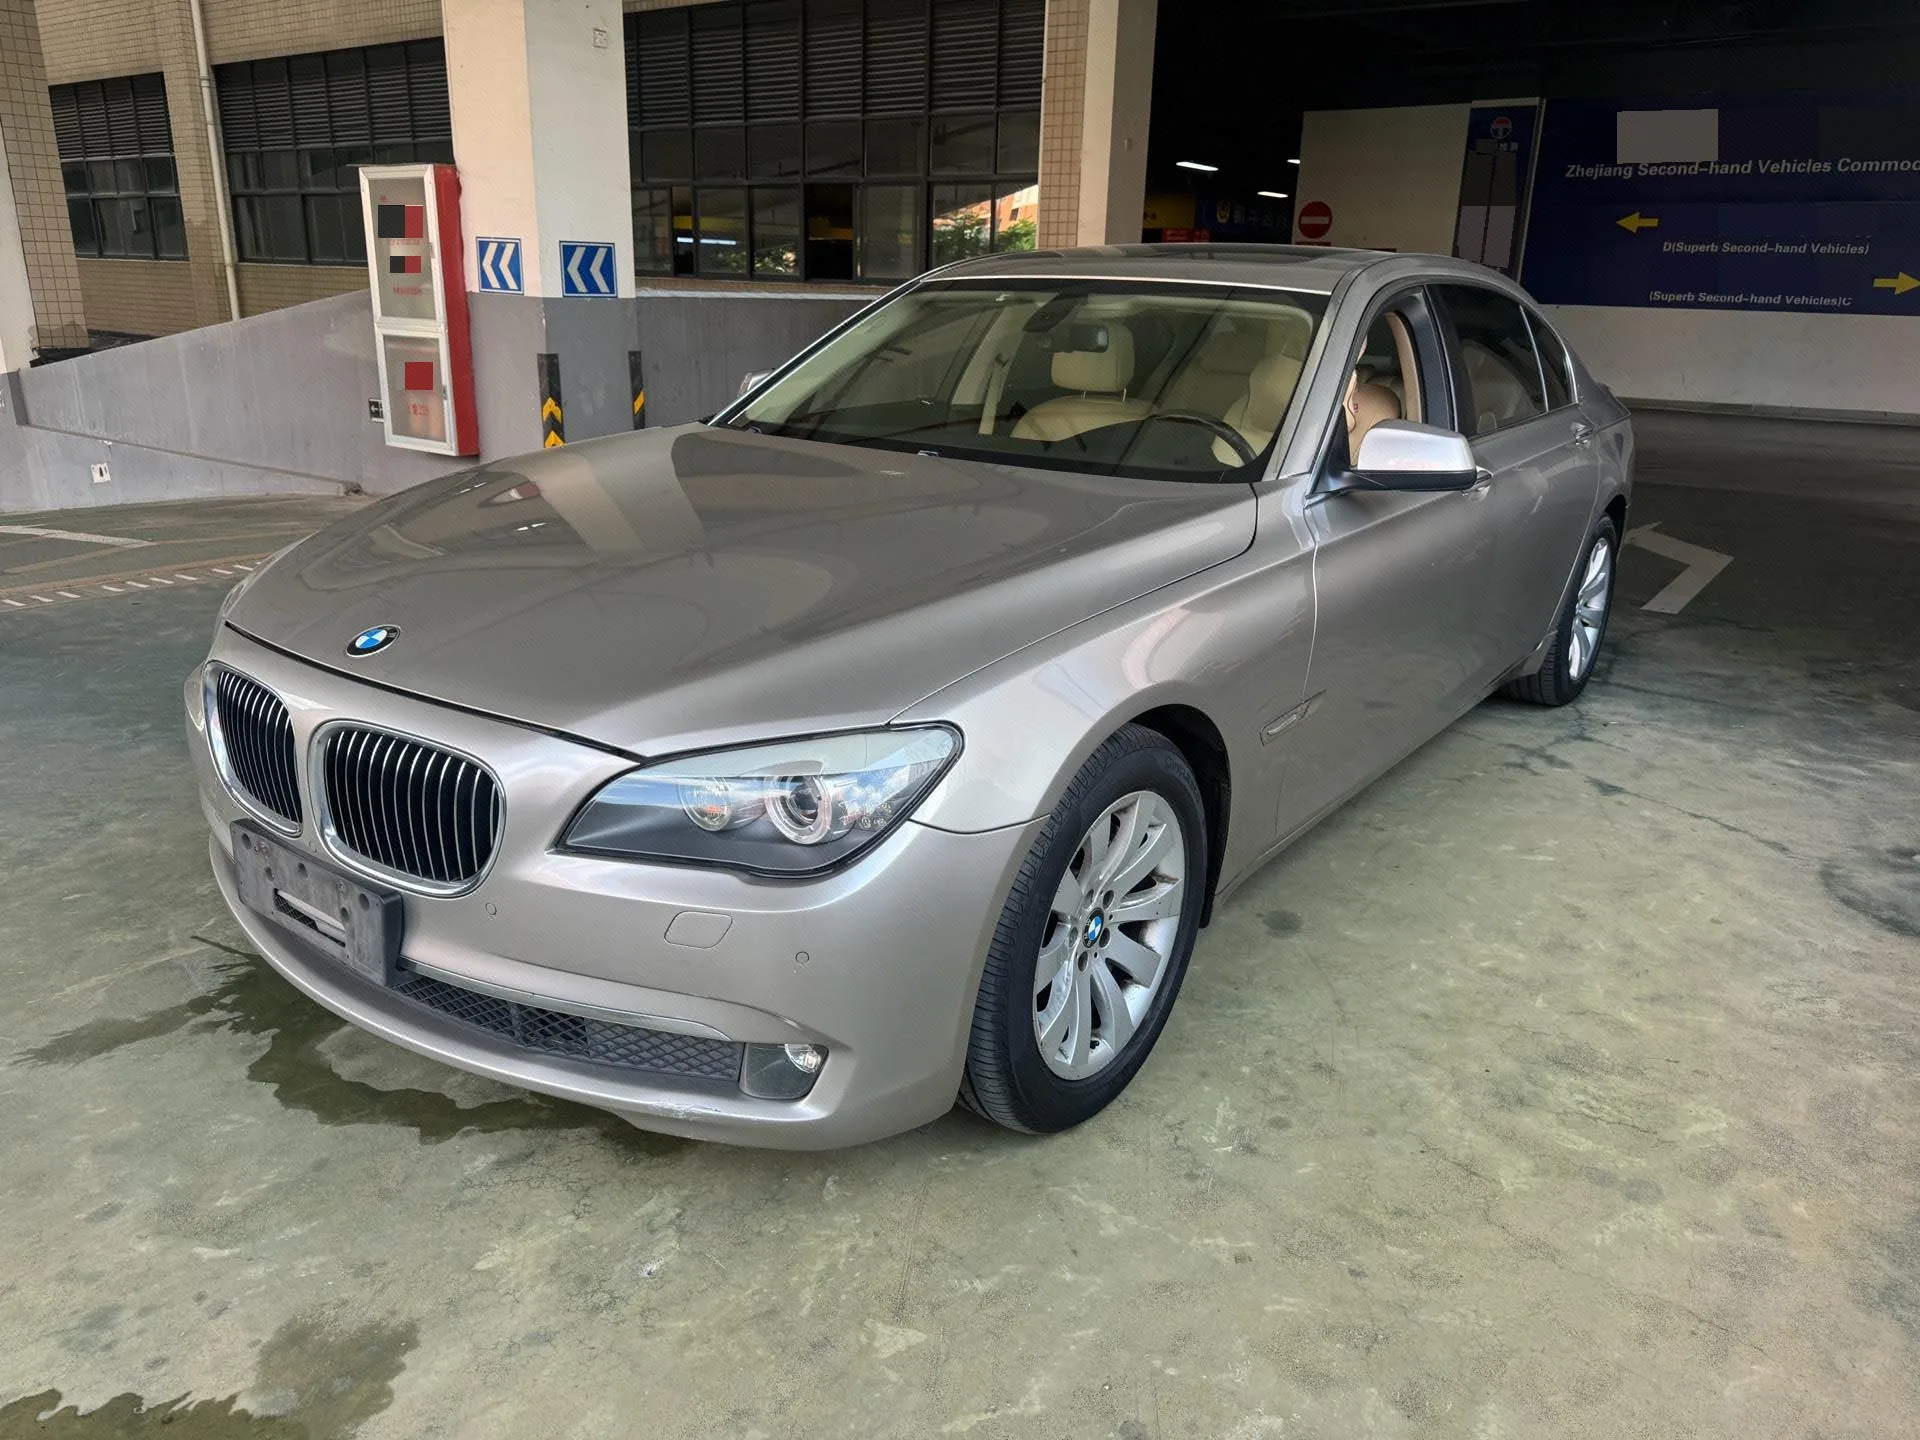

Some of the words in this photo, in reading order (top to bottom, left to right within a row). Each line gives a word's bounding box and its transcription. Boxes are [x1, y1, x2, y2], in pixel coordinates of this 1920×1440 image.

[1565, 164, 1633, 179] Zhejiang
[1637, 160, 1752, 177] Second-hand
[1758, 158, 1831, 174] Vehicles
[1722, 242, 1807, 254] Second-hand
[1811, 243, 1869, 255] Vehicles)
[1649, 291, 1695, 303] (Superb
[1698, 292, 1782, 305] Second-hand
